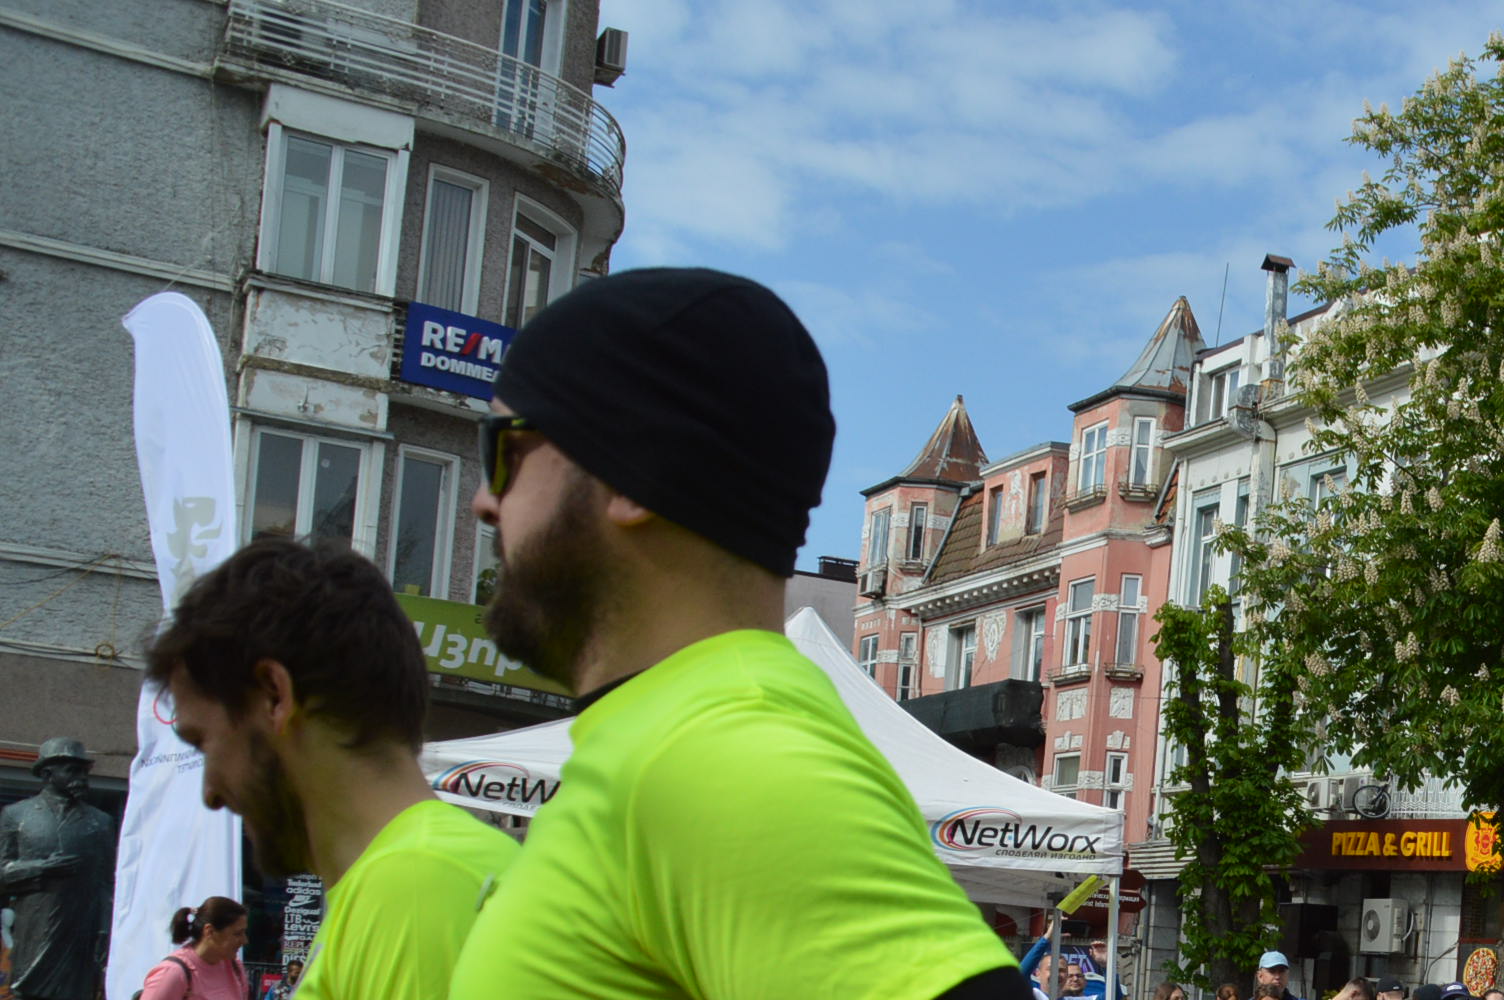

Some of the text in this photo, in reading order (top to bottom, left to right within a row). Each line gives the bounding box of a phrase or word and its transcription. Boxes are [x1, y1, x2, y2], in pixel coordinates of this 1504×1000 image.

[421, 320, 510, 364] RE/M
[947, 818, 1102, 854] NetWorx
[1332, 831, 1452, 857] PIZZA & GRILL
